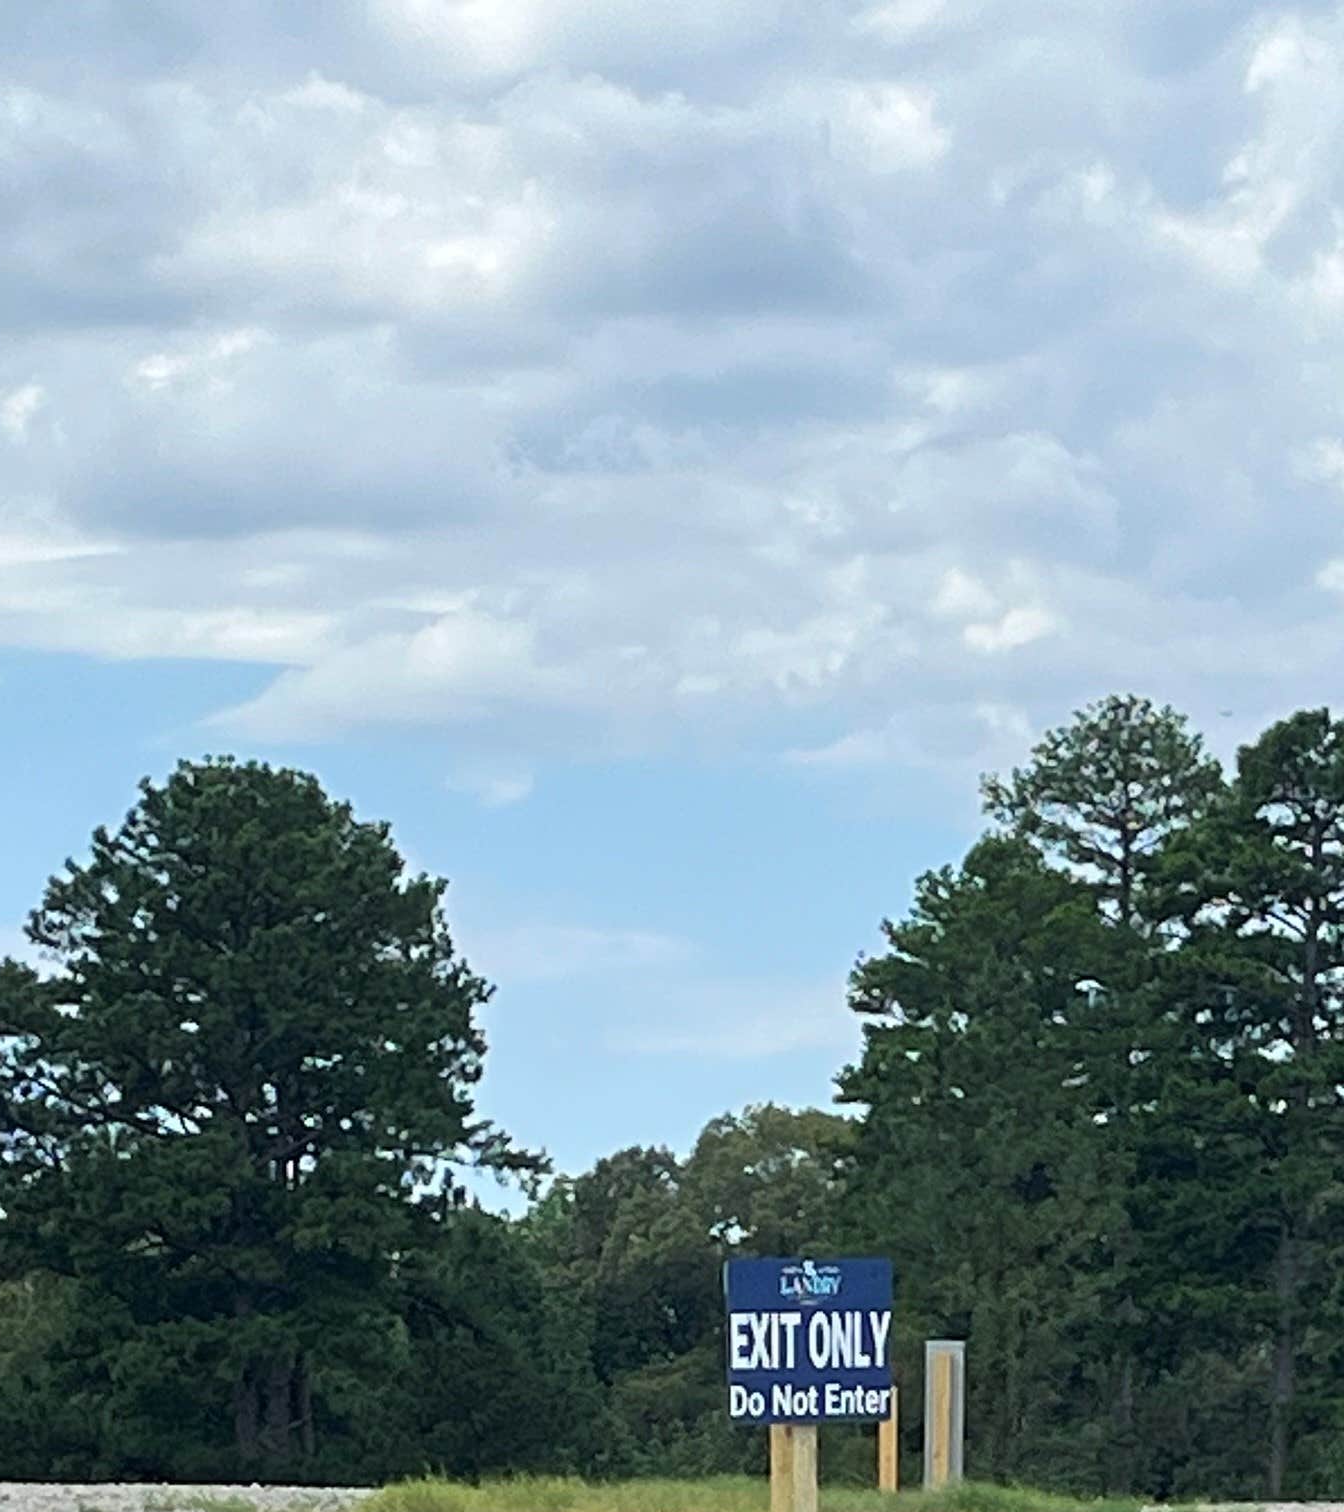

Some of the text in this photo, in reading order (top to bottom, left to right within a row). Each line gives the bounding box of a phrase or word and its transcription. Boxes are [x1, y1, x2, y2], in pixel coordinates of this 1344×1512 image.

[729, 1310, 892, 1370] EXIT ONLY
[730, 1383, 892, 1417] Do Not Enter
